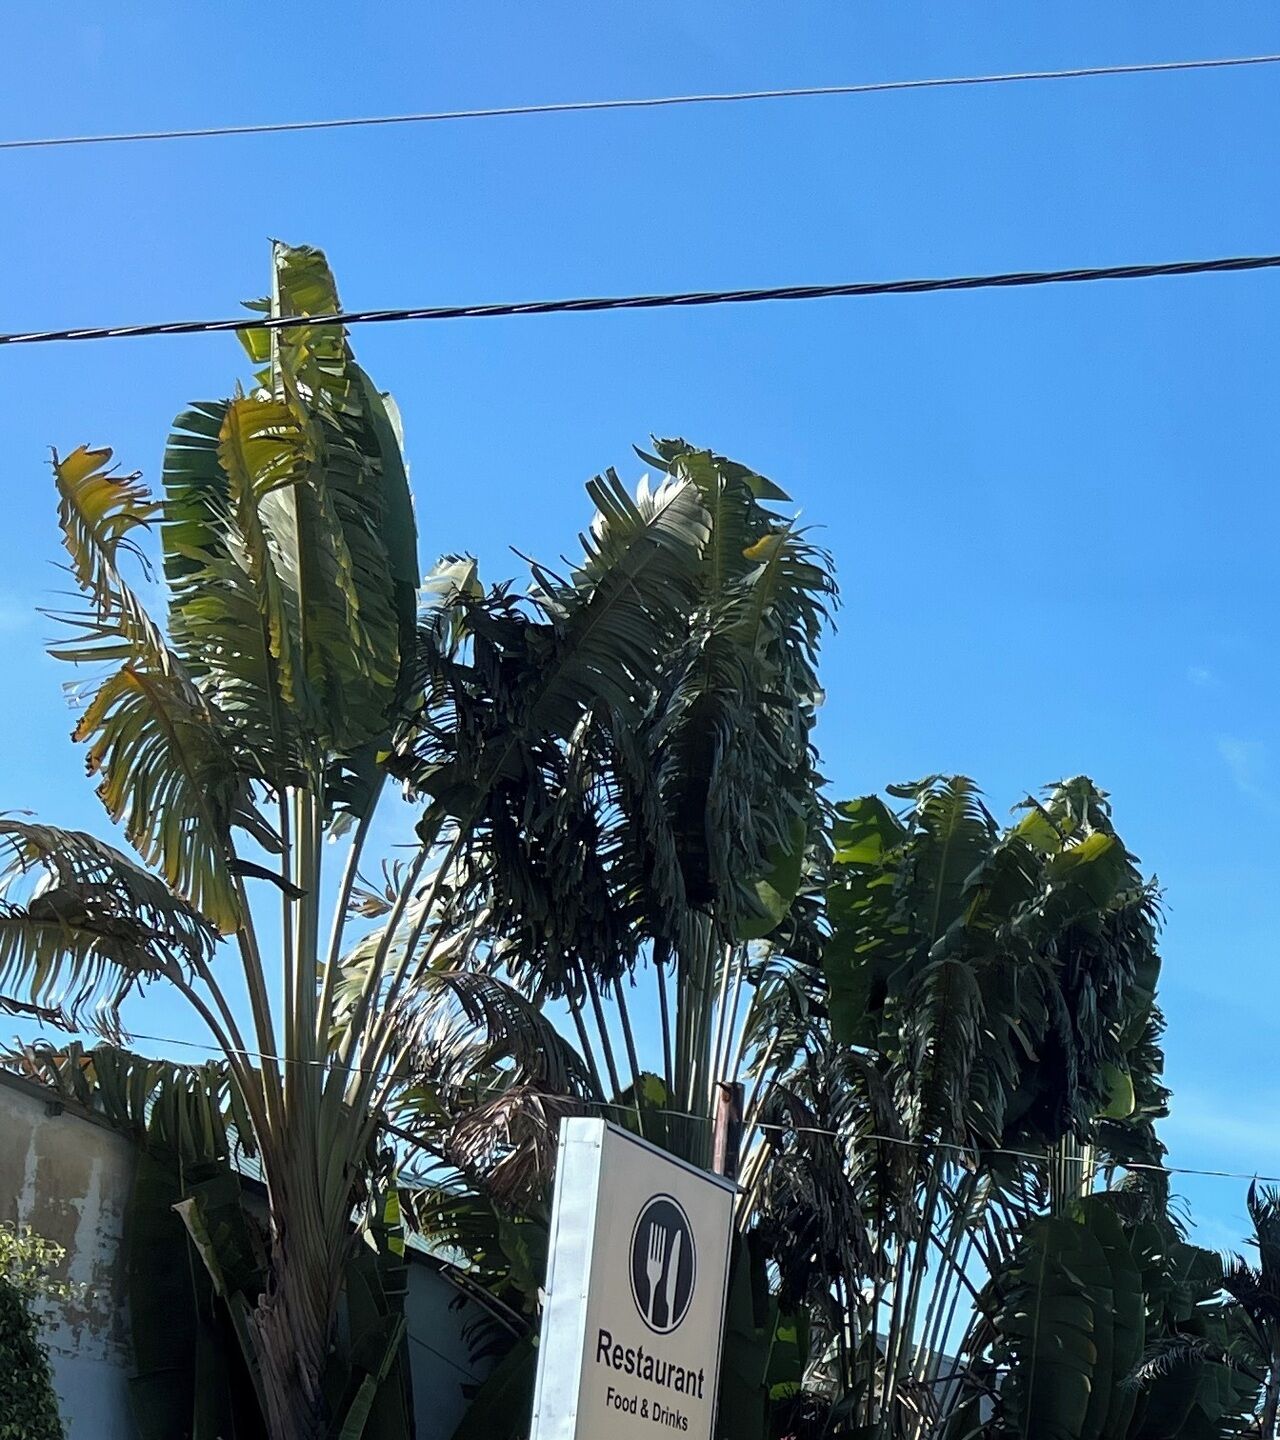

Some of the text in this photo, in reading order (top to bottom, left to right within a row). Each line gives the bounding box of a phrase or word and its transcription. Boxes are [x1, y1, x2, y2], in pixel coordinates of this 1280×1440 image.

[596, 1328, 705, 1400] Restaurant
[606, 1387, 689, 1432] Food & Drinks
